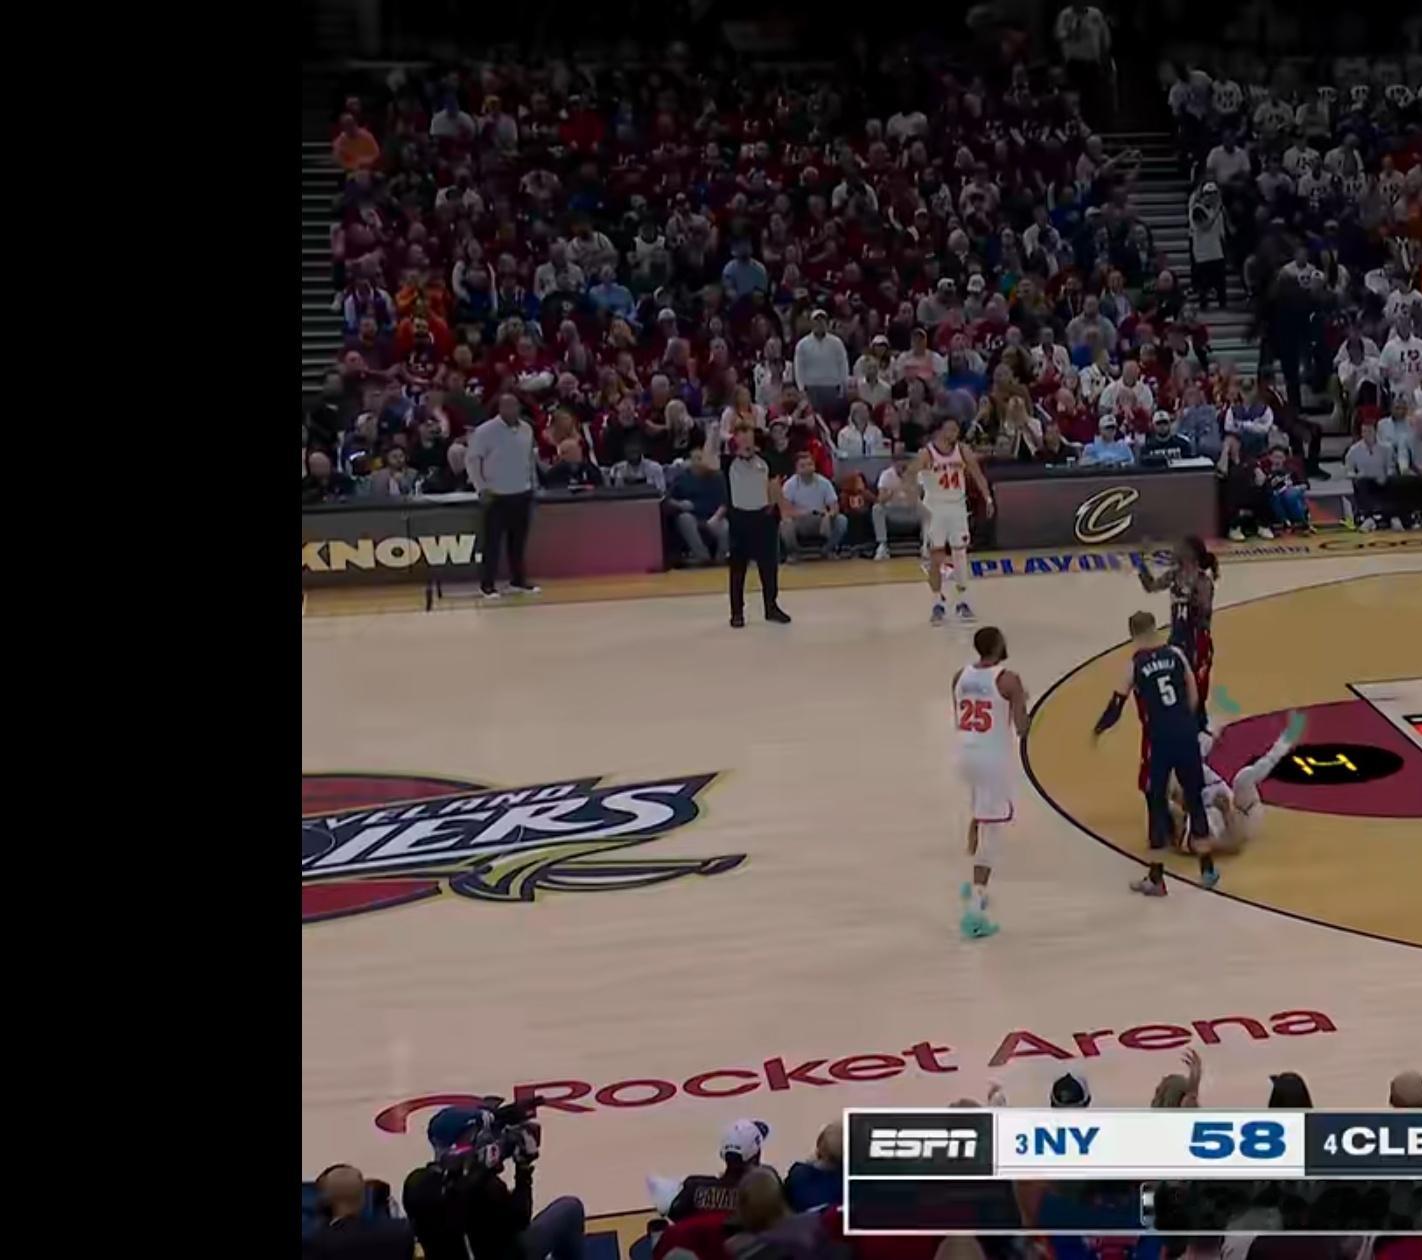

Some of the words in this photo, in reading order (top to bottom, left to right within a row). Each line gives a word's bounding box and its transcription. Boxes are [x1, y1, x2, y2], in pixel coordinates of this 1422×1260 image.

[938, 472, 960, 489] 44
[302, 534, 483, 572] KNOW.
[1157, 675, 1177, 707] 5
[960, 699, 993, 732] 25
[513, 1041, 958, 1118] Rocket
[988, 1009, 1338, 1067] Arena
